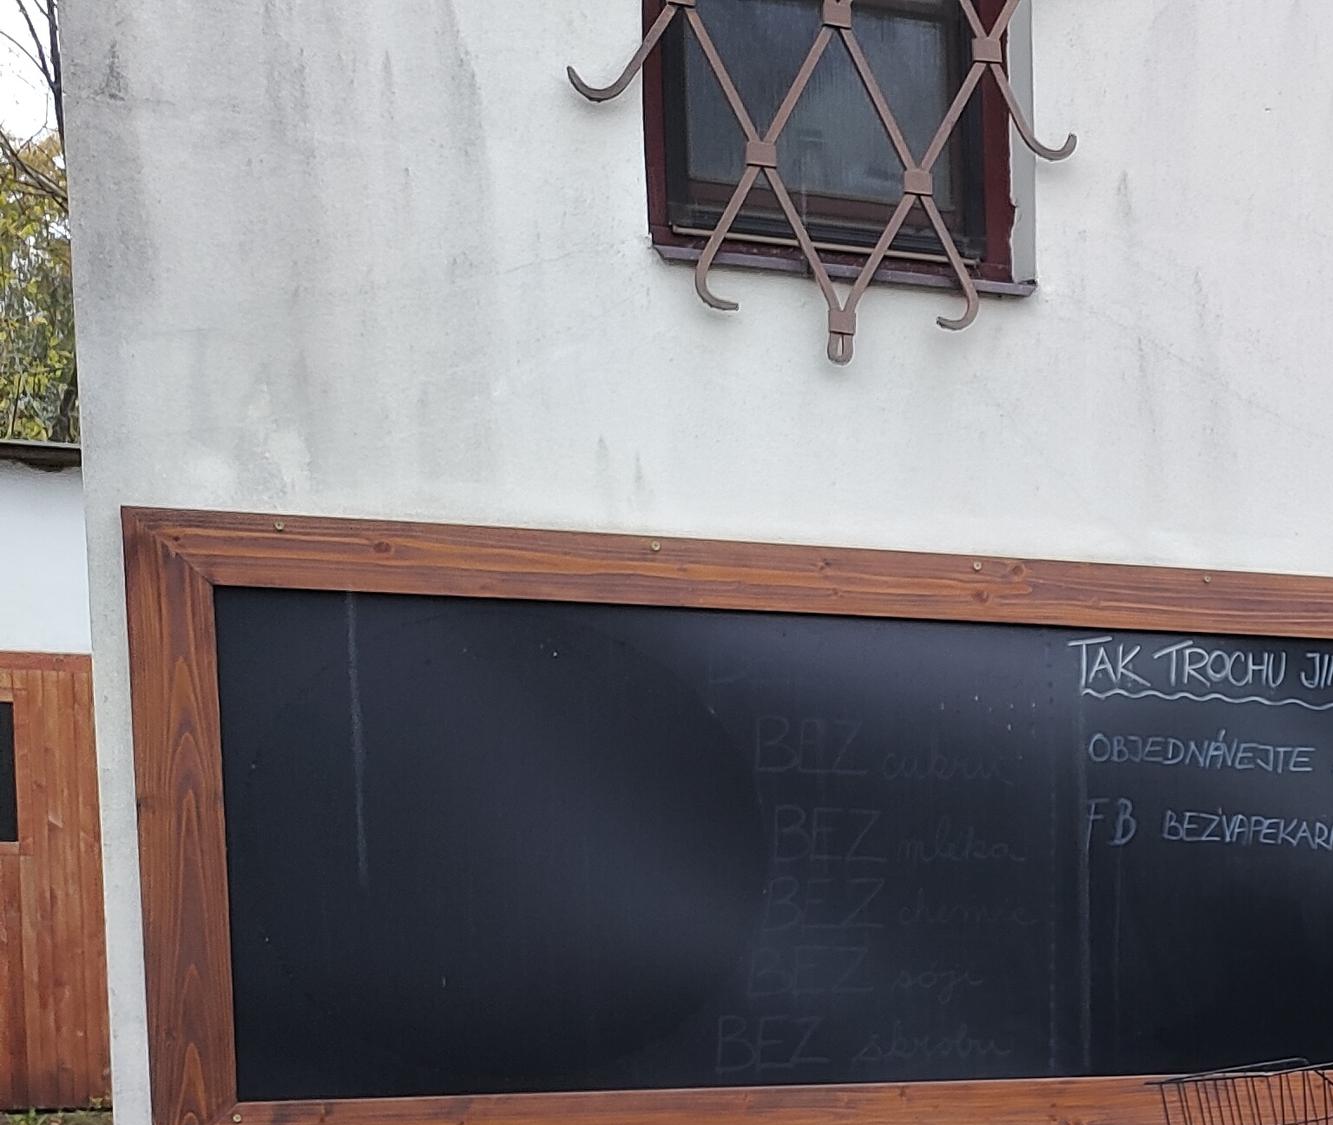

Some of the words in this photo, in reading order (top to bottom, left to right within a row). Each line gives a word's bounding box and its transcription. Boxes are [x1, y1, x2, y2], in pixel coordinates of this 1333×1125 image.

[1068, 636, 1151, 687] TAK
[1153, 640, 1287, 687] TROCHU
[1088, 729, 1316, 774] OBJEDNÁVEJTE
[773, 803, 888, 863] BEZ
[1086, 798, 1137, 849] FB
[761, 876, 885, 932] BEZ
[747, 945, 875, 999] BEZ
[715, 1014, 832, 1074] BEZ
